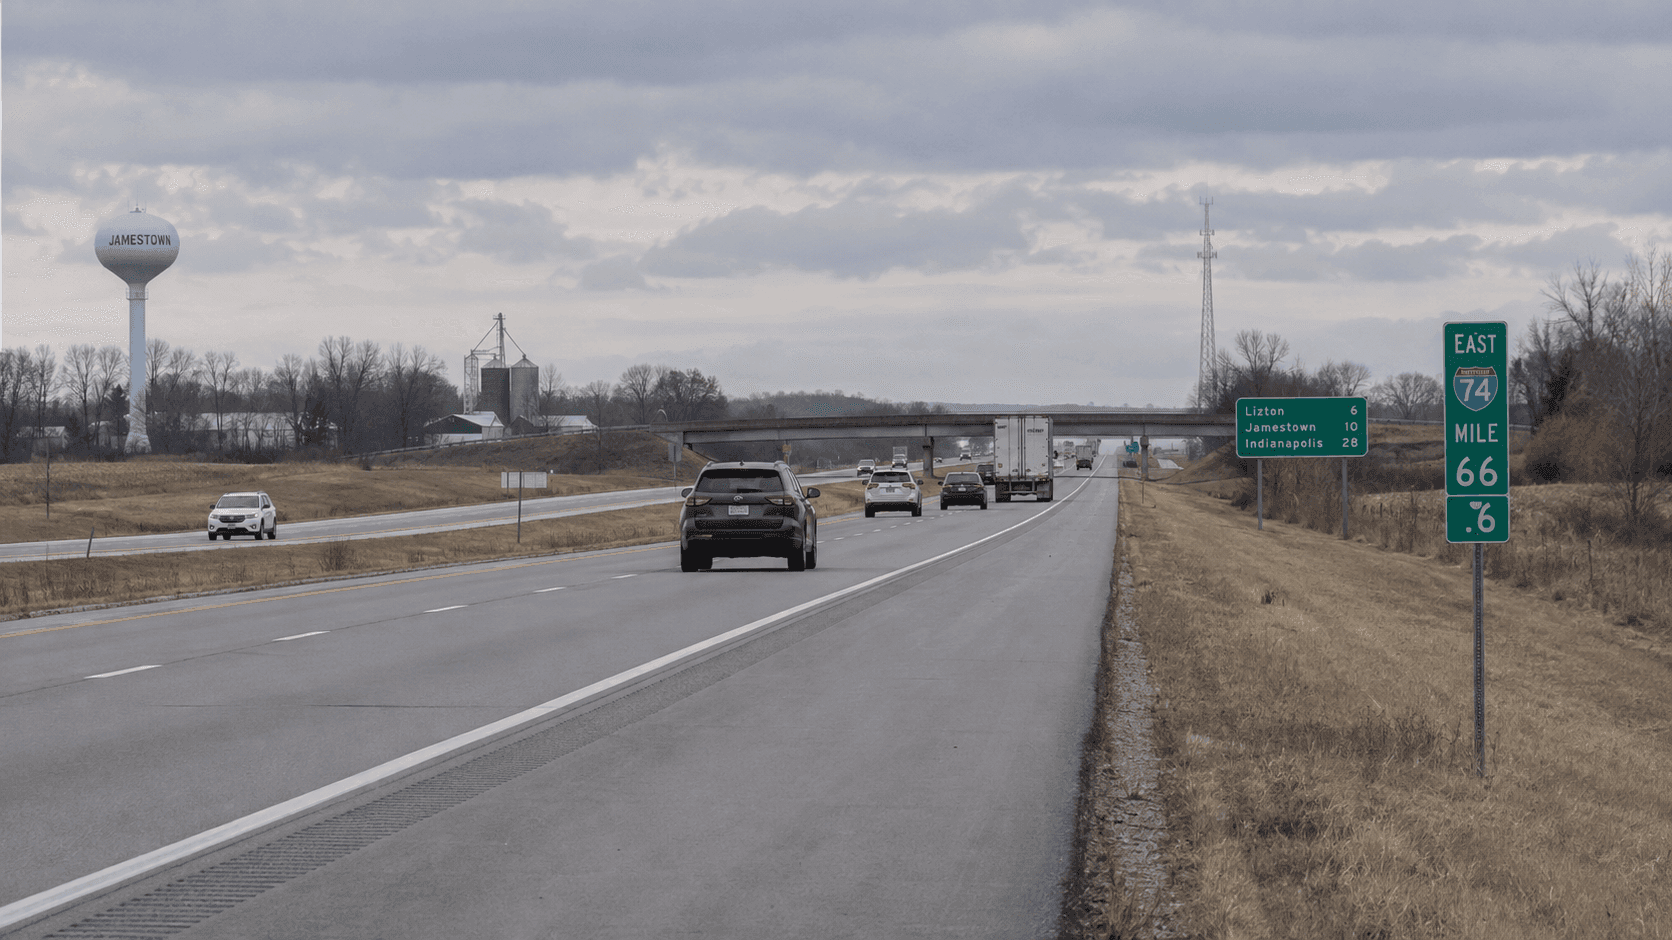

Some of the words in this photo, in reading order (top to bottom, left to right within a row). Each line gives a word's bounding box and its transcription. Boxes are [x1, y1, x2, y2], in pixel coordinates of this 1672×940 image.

[109, 234, 171, 246] JAMESTOWN
[1455, 333, 1496, 354] EAST
[1460, 378, 1491, 402] 74
[1245, 405, 1285, 416] Lizton
[1350, 405, 1358, 415] 6
[1245, 422, 1316, 432] Jamestown
[1345, 421, 1358, 431] 10
[1455, 423, 1498, 443] MILE
[1245, 438, 1323, 450] Indianapolis
[1342, 437, 1358, 448] 28
[1456, 456, 1498, 487] 66
